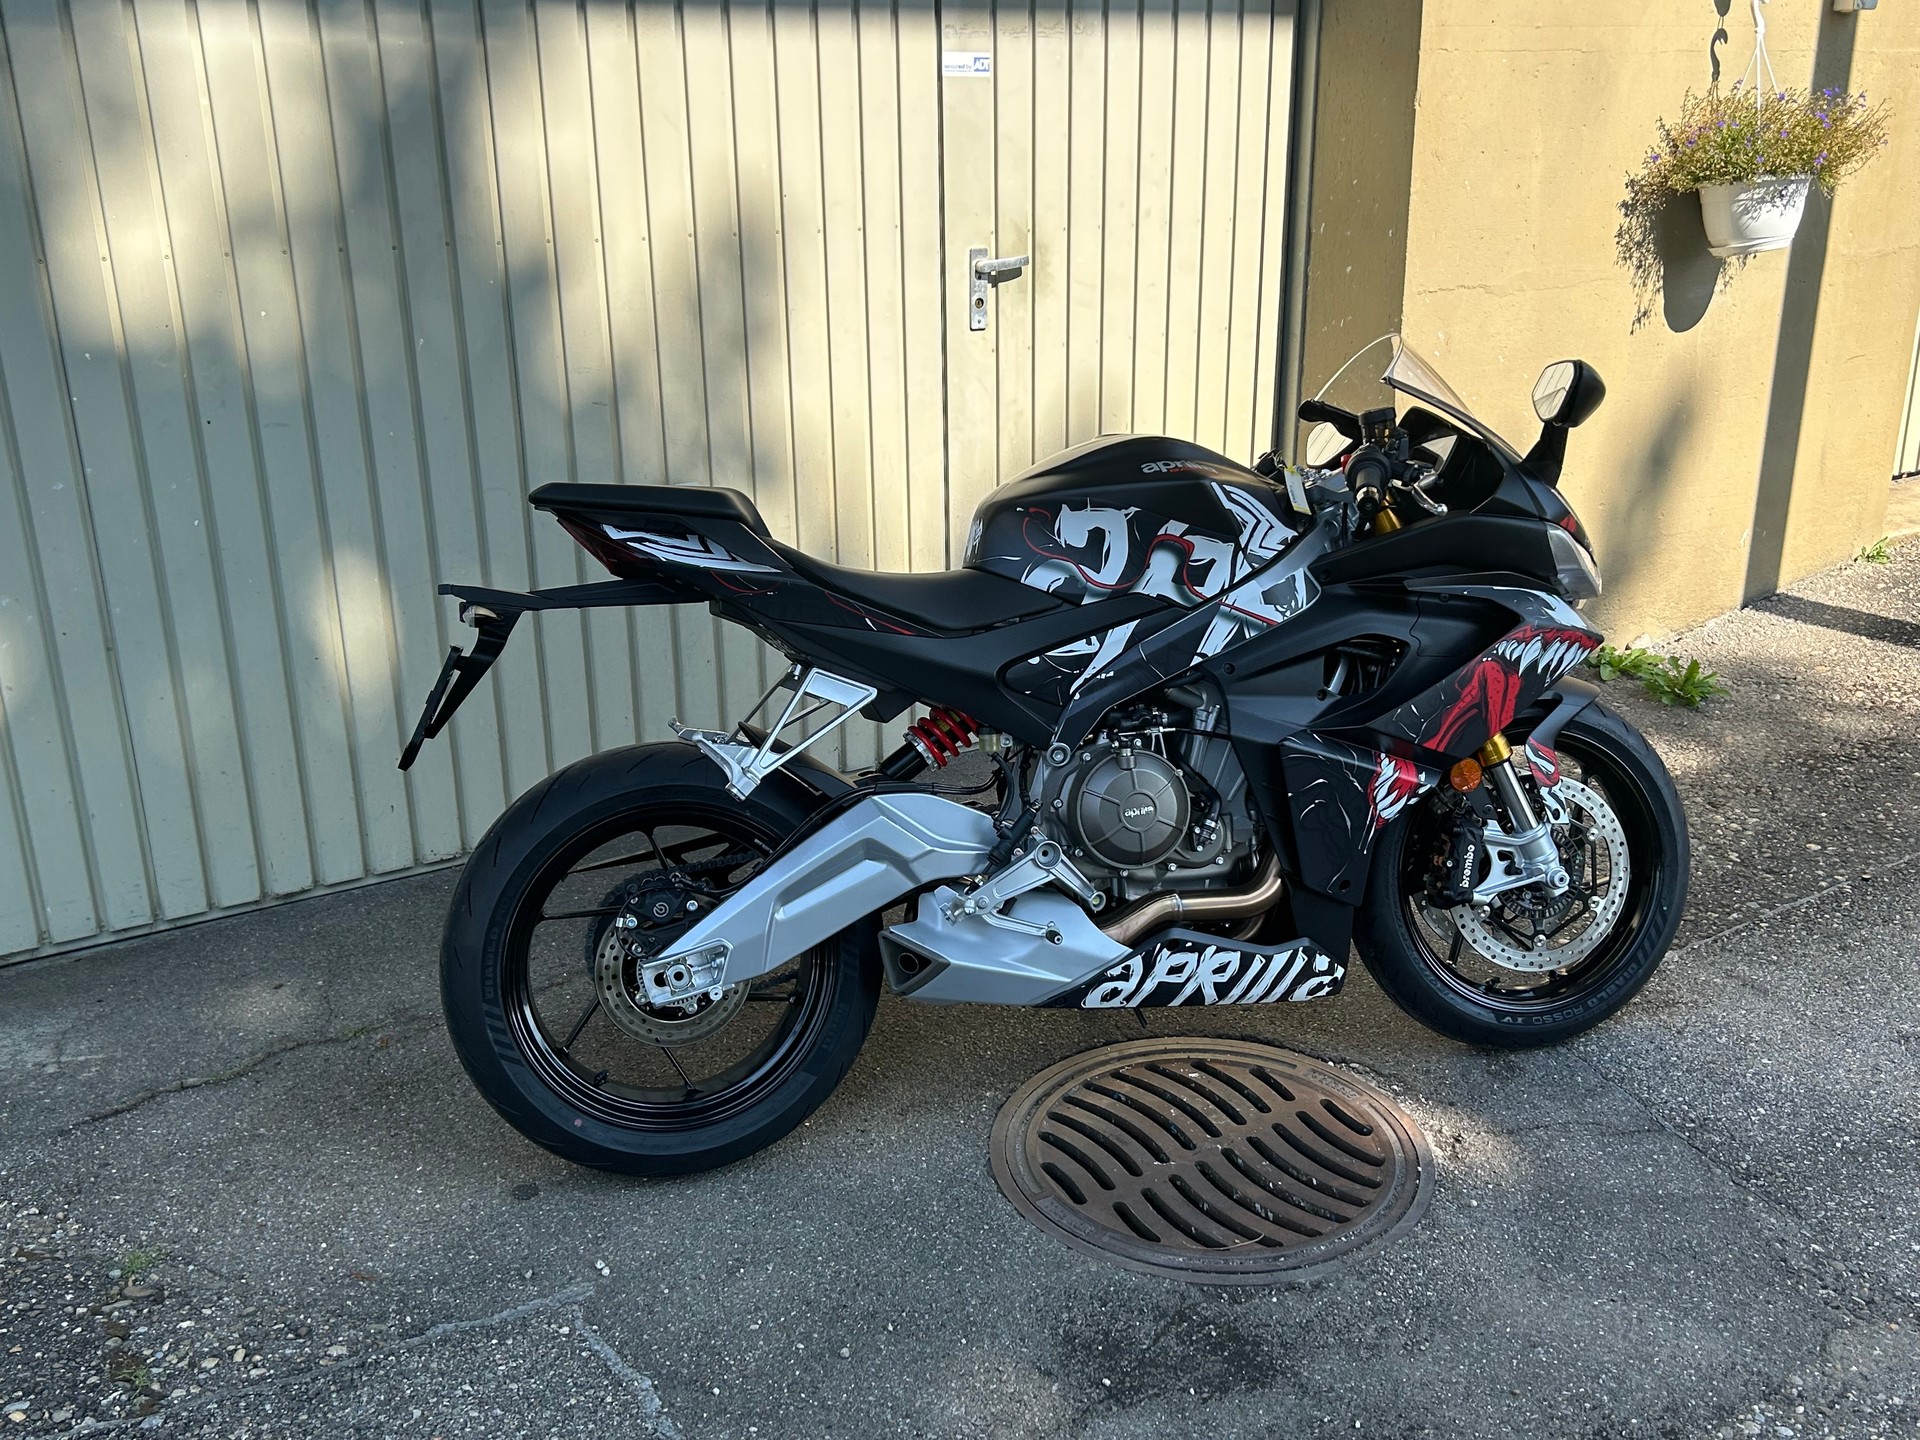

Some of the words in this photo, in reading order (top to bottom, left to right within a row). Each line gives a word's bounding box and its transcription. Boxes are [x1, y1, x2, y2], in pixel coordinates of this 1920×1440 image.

[1459, 844, 1476, 888] brembo
[1586, 961, 1640, 1007] DIABLO
[1501, 1015, 1524, 1025] IV
[1532, 1005, 1585, 1026] ROSSO
